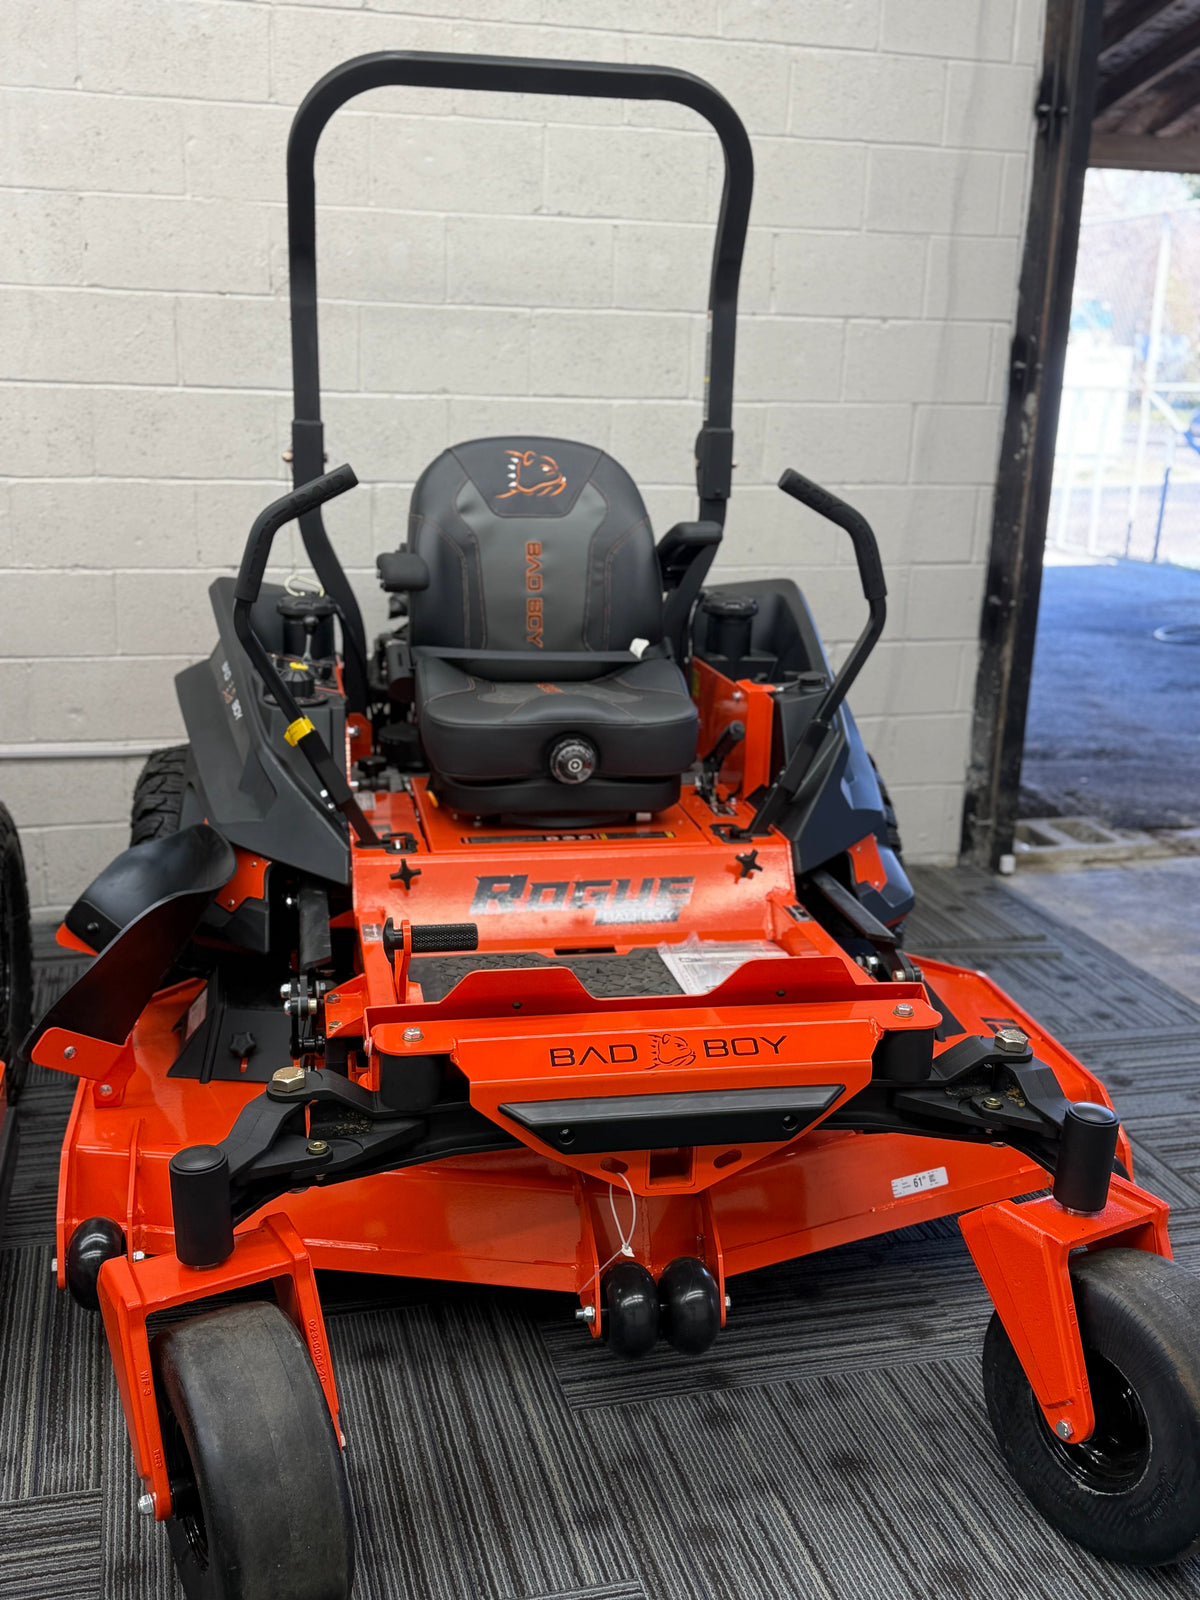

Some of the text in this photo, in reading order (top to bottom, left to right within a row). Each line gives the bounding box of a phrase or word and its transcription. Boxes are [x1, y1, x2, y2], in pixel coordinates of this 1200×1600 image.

[525, 541, 543, 649] BAD BOY
[549, 1035, 787, 1068] BAD BOY
